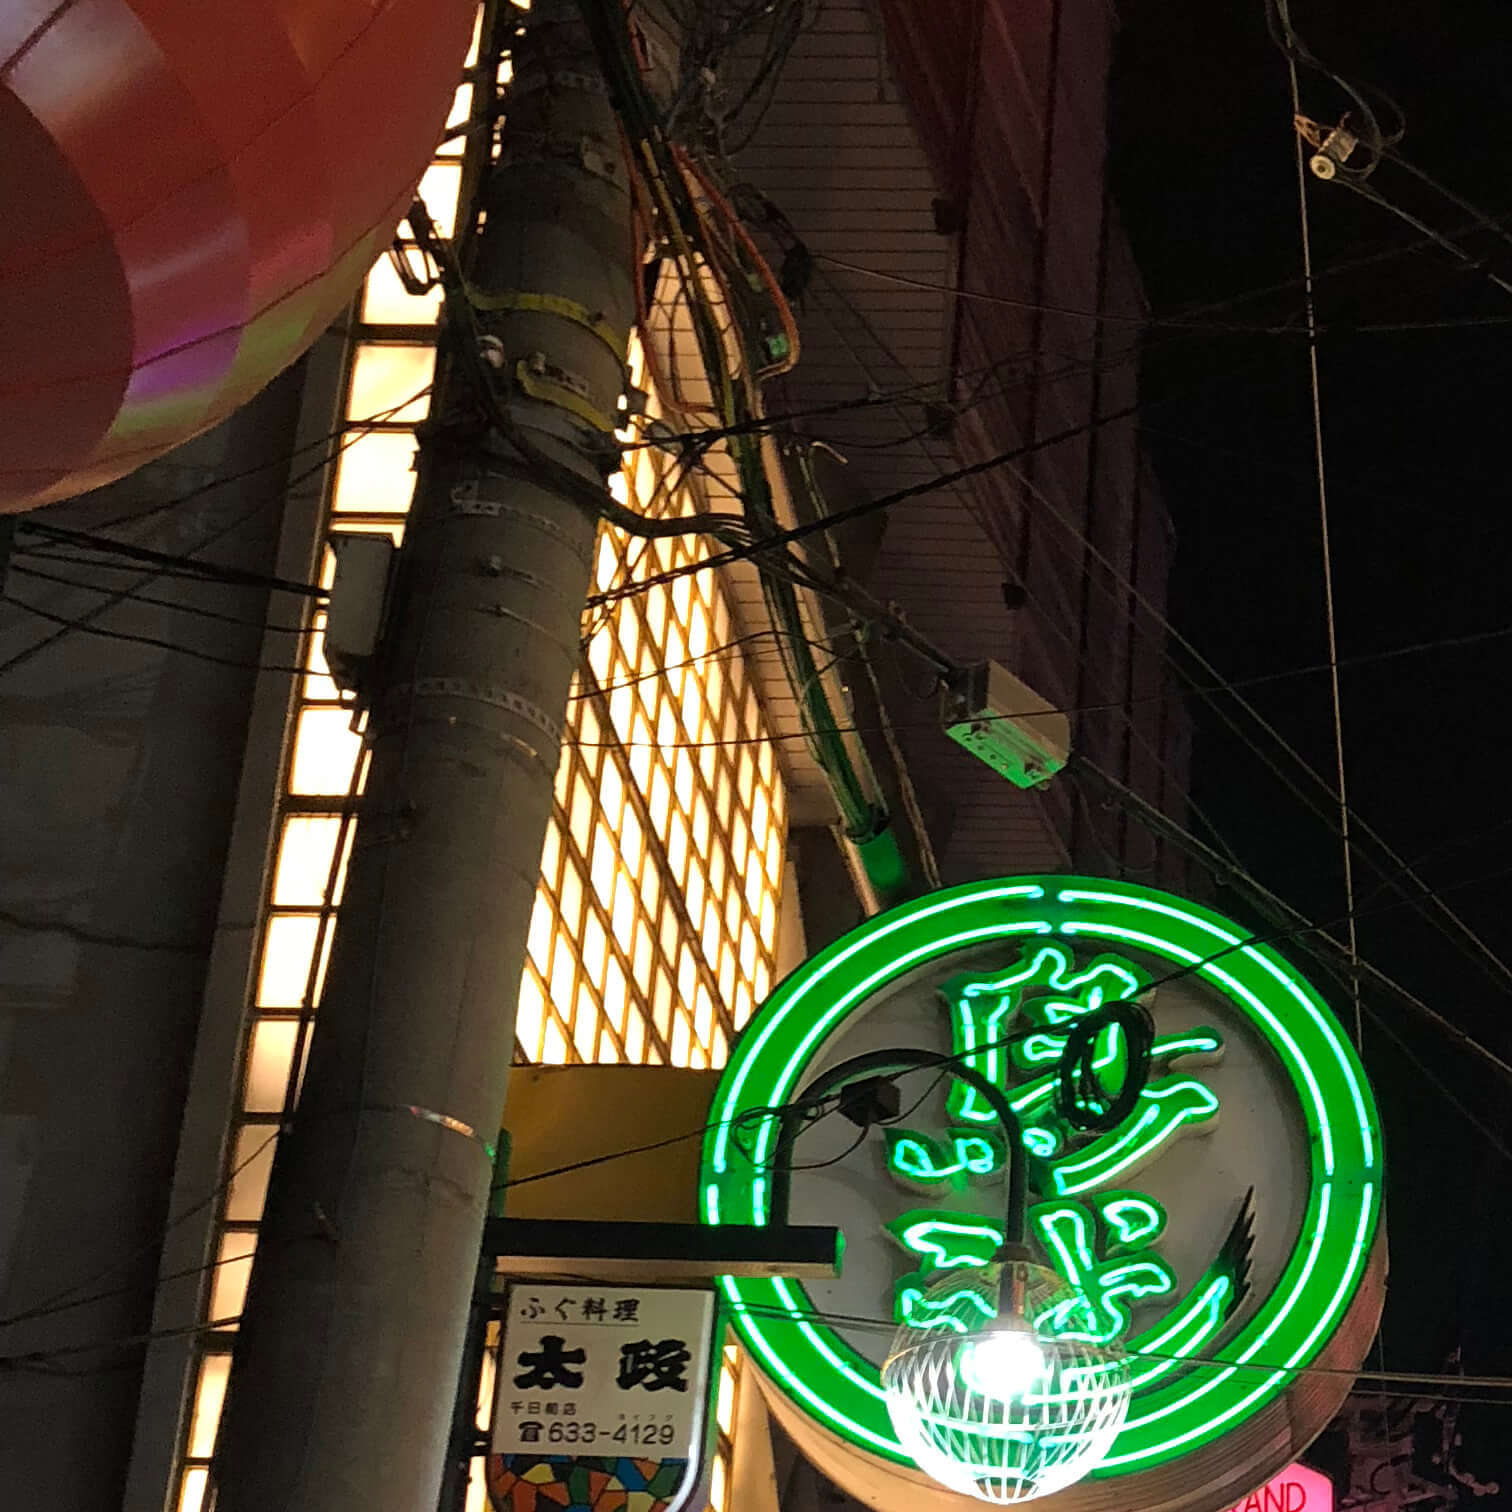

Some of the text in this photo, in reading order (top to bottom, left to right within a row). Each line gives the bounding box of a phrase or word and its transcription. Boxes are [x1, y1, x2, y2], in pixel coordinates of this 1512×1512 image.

[520, 1297, 641, 1322] ふぐ料理
[513, 1334, 692, 1393] 太政
[510, 1400, 577, 1416] 千日前店
[548, 1421, 675, 1446] 633-4129
